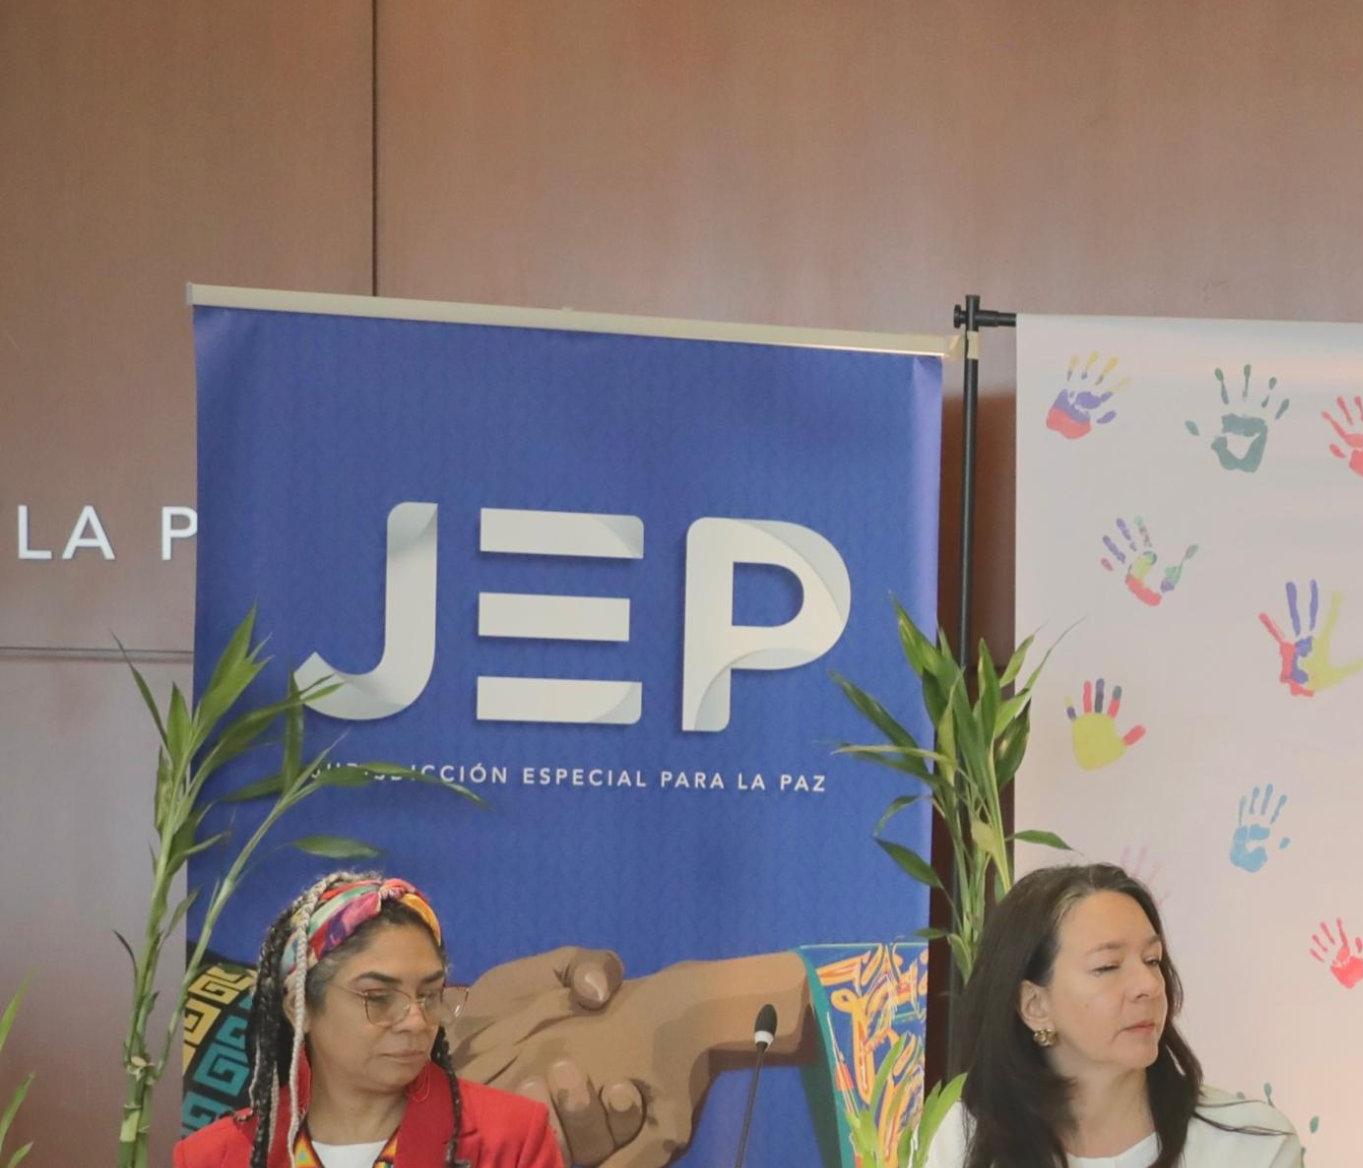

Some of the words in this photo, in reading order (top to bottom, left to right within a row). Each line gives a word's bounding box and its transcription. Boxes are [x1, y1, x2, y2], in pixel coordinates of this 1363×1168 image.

[18, 505, 115, 559] LA
[294, 501, 852, 732] JEP
[523, 767, 647, 787] ESPECIAL
[660, 771, 724, 789] PARA
[737, 772, 766, 791] LA
[780, 774, 826, 792] PAZ
